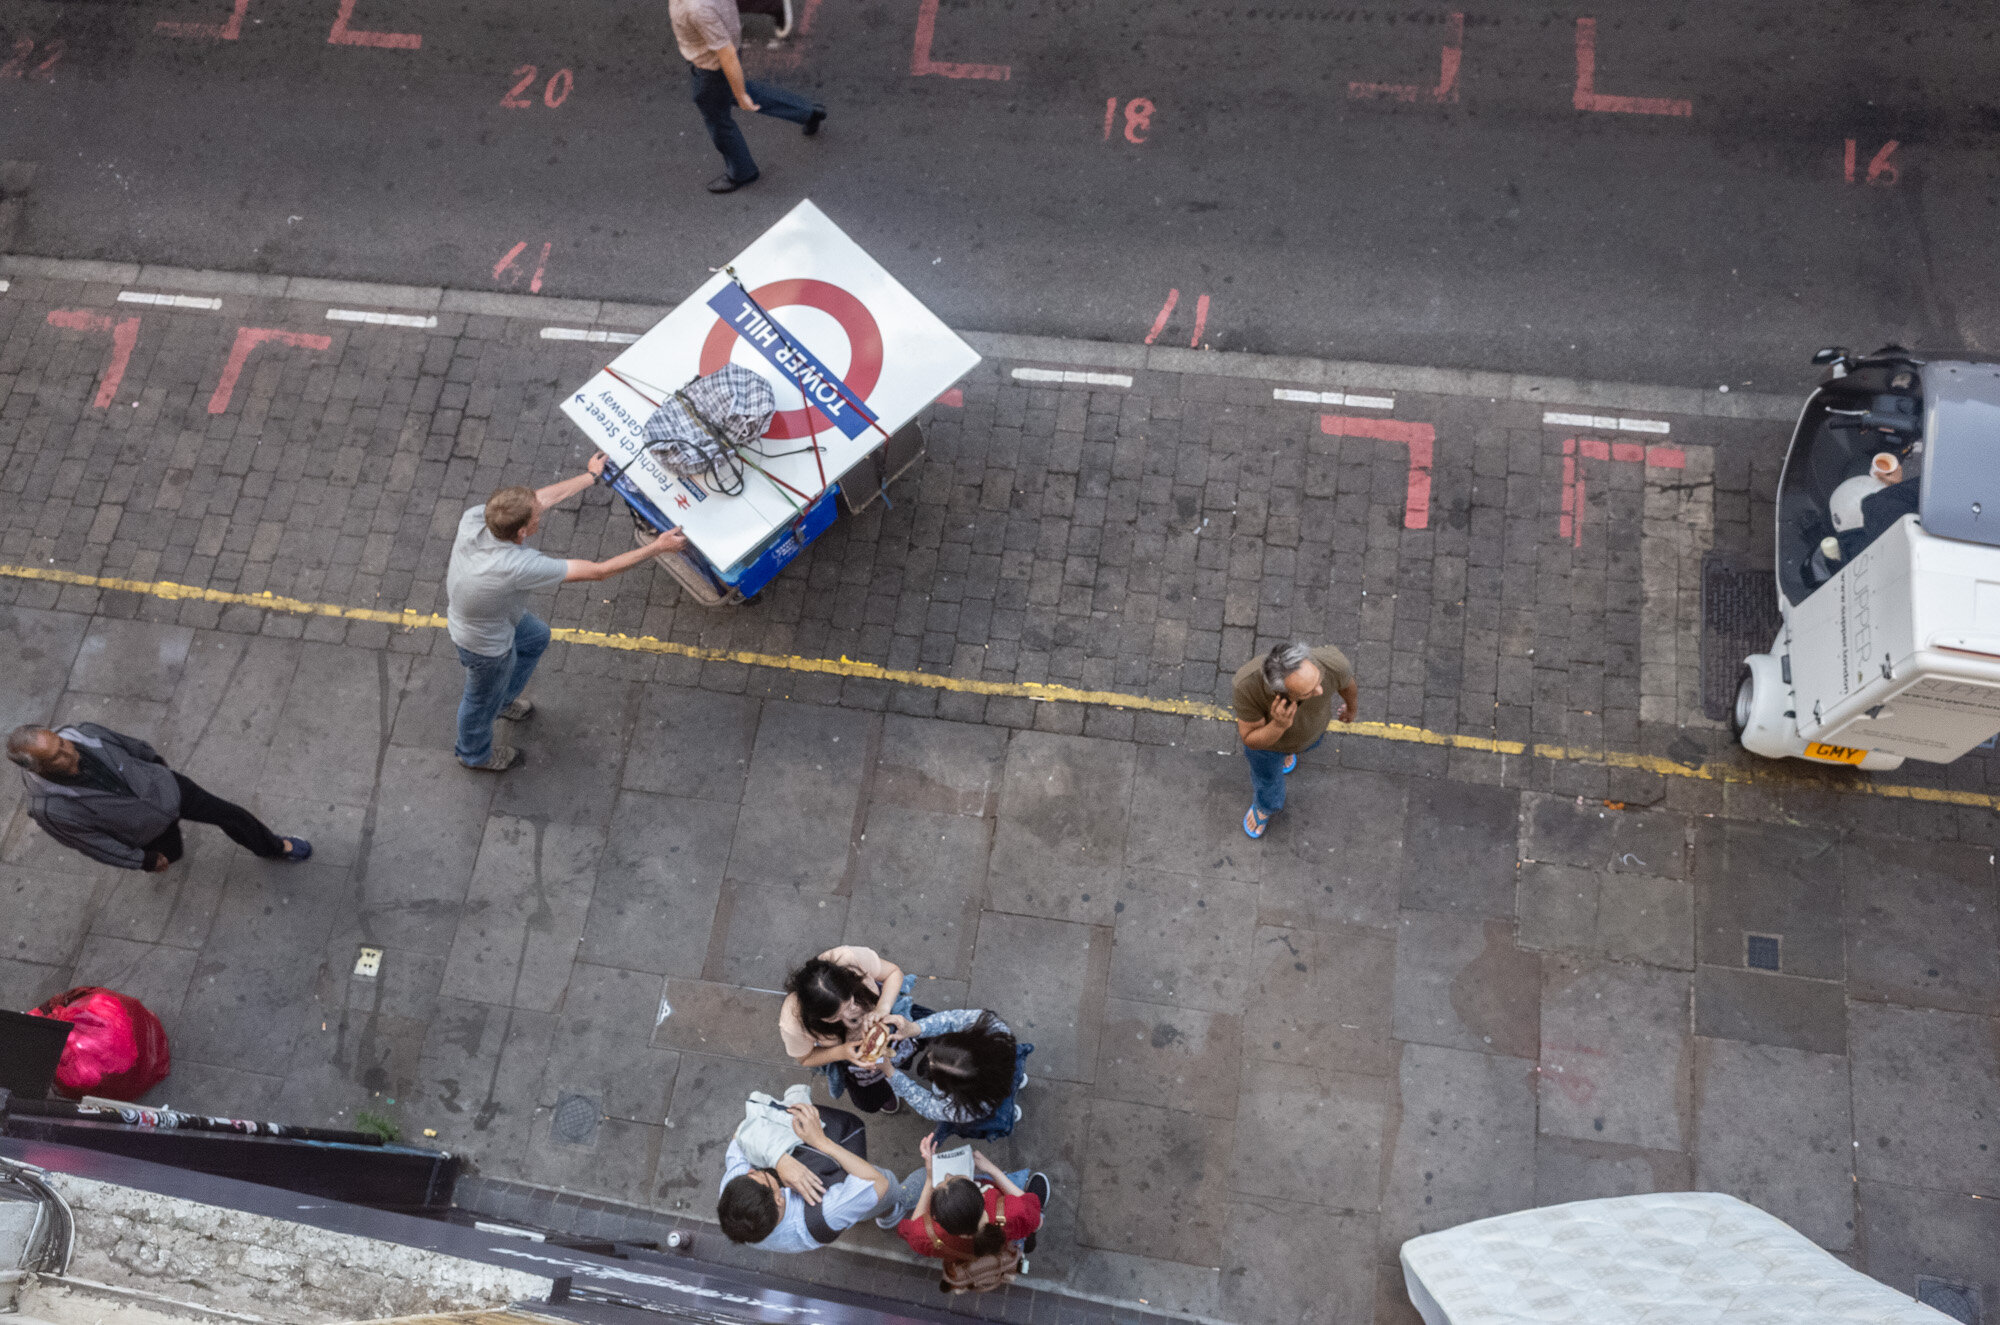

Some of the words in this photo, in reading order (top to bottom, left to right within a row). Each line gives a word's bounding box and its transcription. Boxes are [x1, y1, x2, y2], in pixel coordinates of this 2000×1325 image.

[500, 65, 574, 109] 20
[1104, 97, 1156, 143] 18
[1844, 139, 1900, 186] 16
[735, 302, 779, 348] HILL
[774, 341, 849, 417] TOWER
[585, 402, 620, 438] Street
[598, 390, 643, 437] Gateway
[619, 436, 673, 492] Fenchurch
[1816, 744, 1861, 759] GMY
